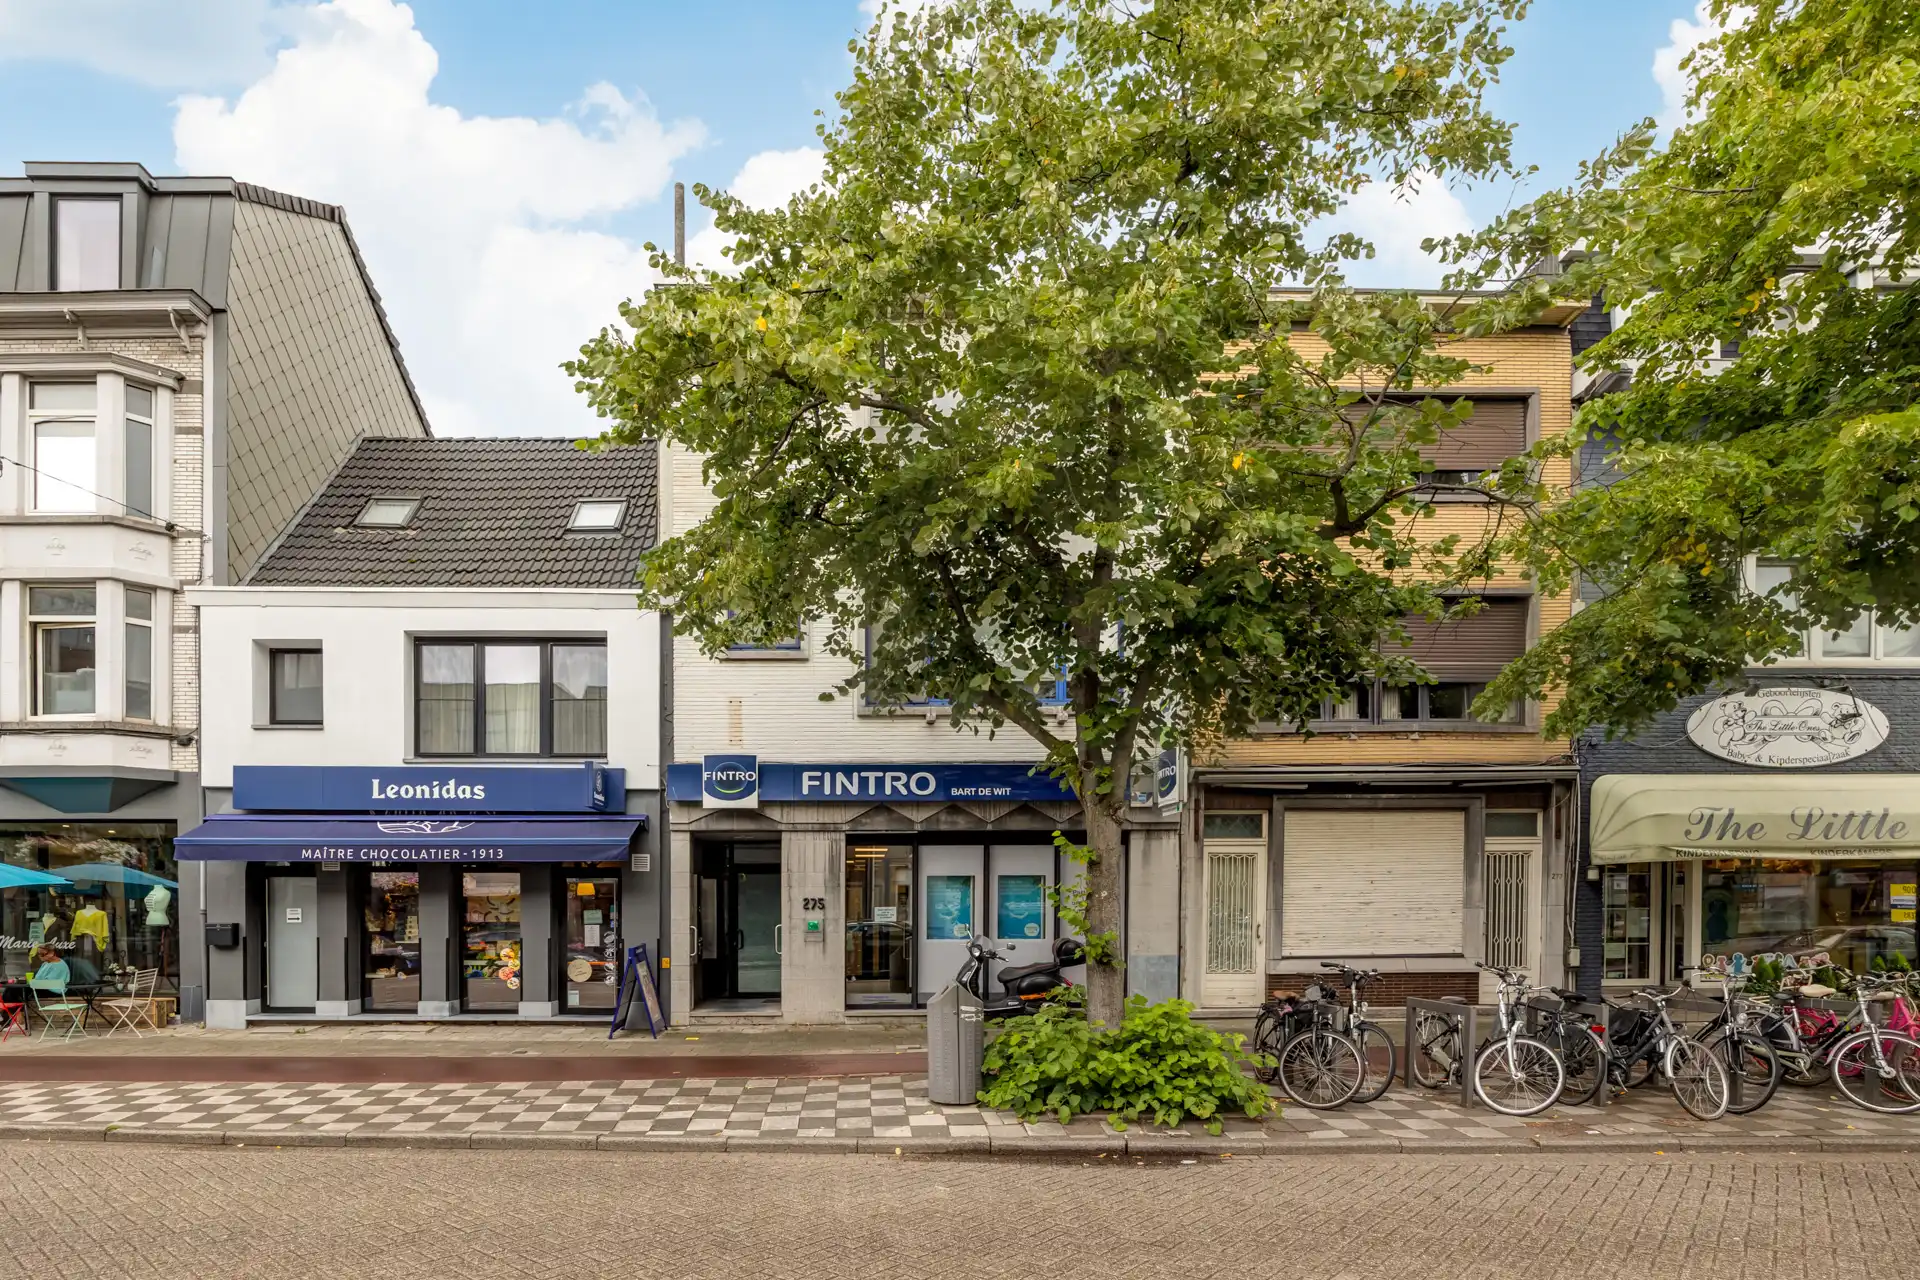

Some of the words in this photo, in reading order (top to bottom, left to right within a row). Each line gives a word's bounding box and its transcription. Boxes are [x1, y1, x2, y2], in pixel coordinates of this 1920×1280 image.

[1757, 689, 1821, 698] Geboortelijsten
[1745, 720, 1767, 731] The
[1798, 720, 1821, 731] Ones
[1755, 753, 1763, 762] &
[1768, 749, 1851, 765] Kinderspeciaalzaak
[704, 771, 756, 781] FINTRO
[371, 778, 486, 800] Leonidas
[802, 771, 937, 795] FINTRO
[951, 788, 976, 796] BART
[978, 788, 992, 796] DE
[993, 788, 1012, 796] WIT
[1684, 806, 1768, 841] The
[1786, 806, 1910, 841] Little
[301, 846, 354, 859] MAÎTRE
[803, 897, 825, 910] 275
